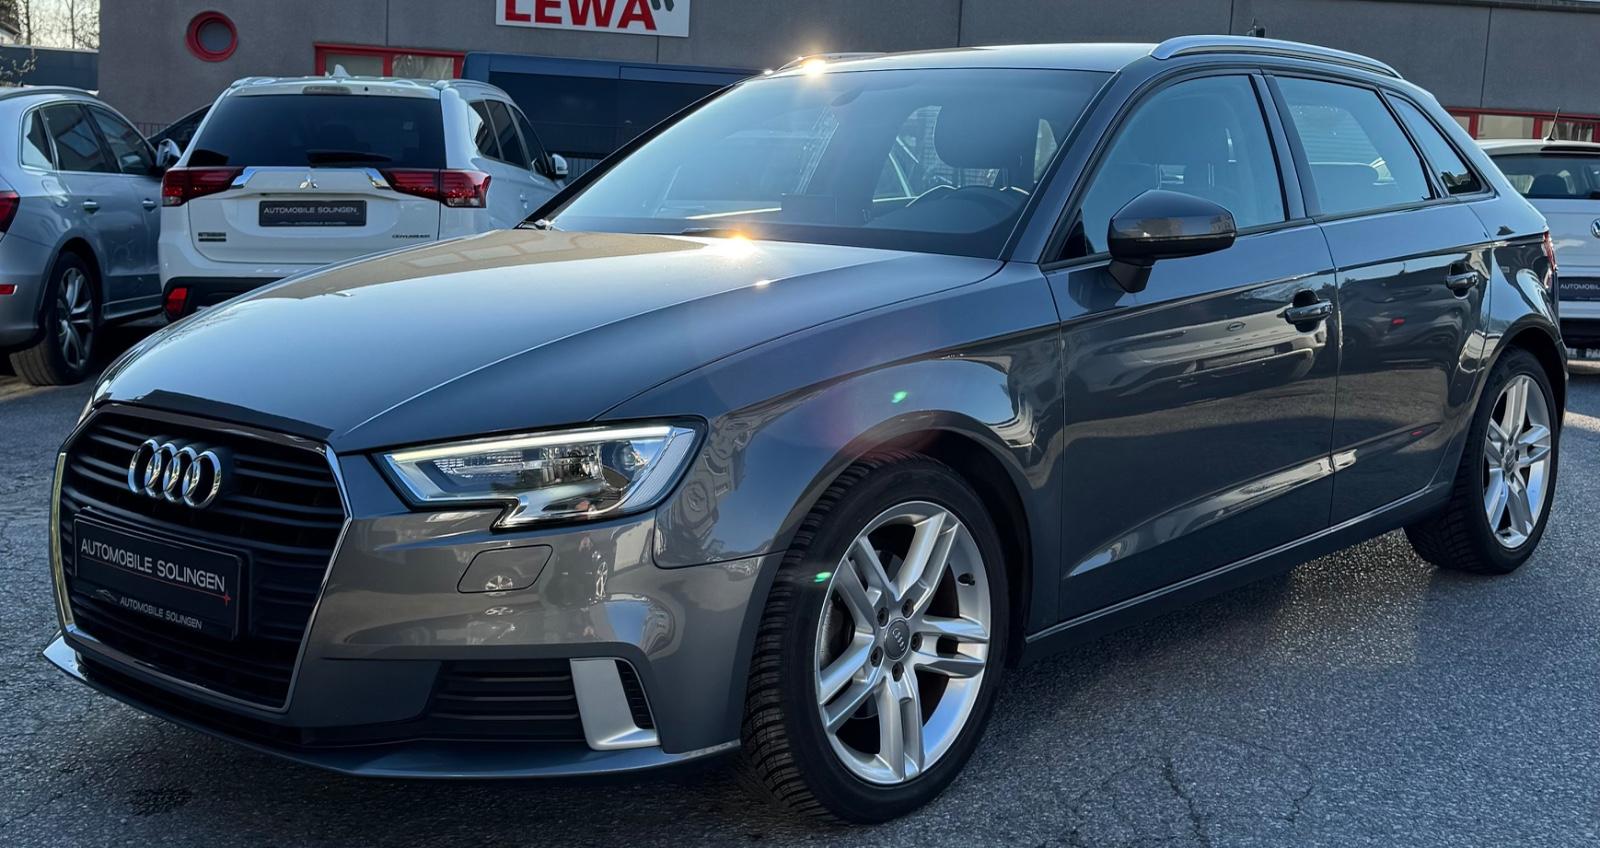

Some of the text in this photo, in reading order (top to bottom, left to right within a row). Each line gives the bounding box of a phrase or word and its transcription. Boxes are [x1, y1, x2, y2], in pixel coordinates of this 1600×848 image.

[505, 0, 657, 30] LEWA
[263, 206, 358, 214] AUTOMOBILE SOLINGEN
[80, 538, 225, 592] AUTOMOBILE SOLINGEN
[119, 596, 202, 630] AUTOMOBILE SOLINGEN
